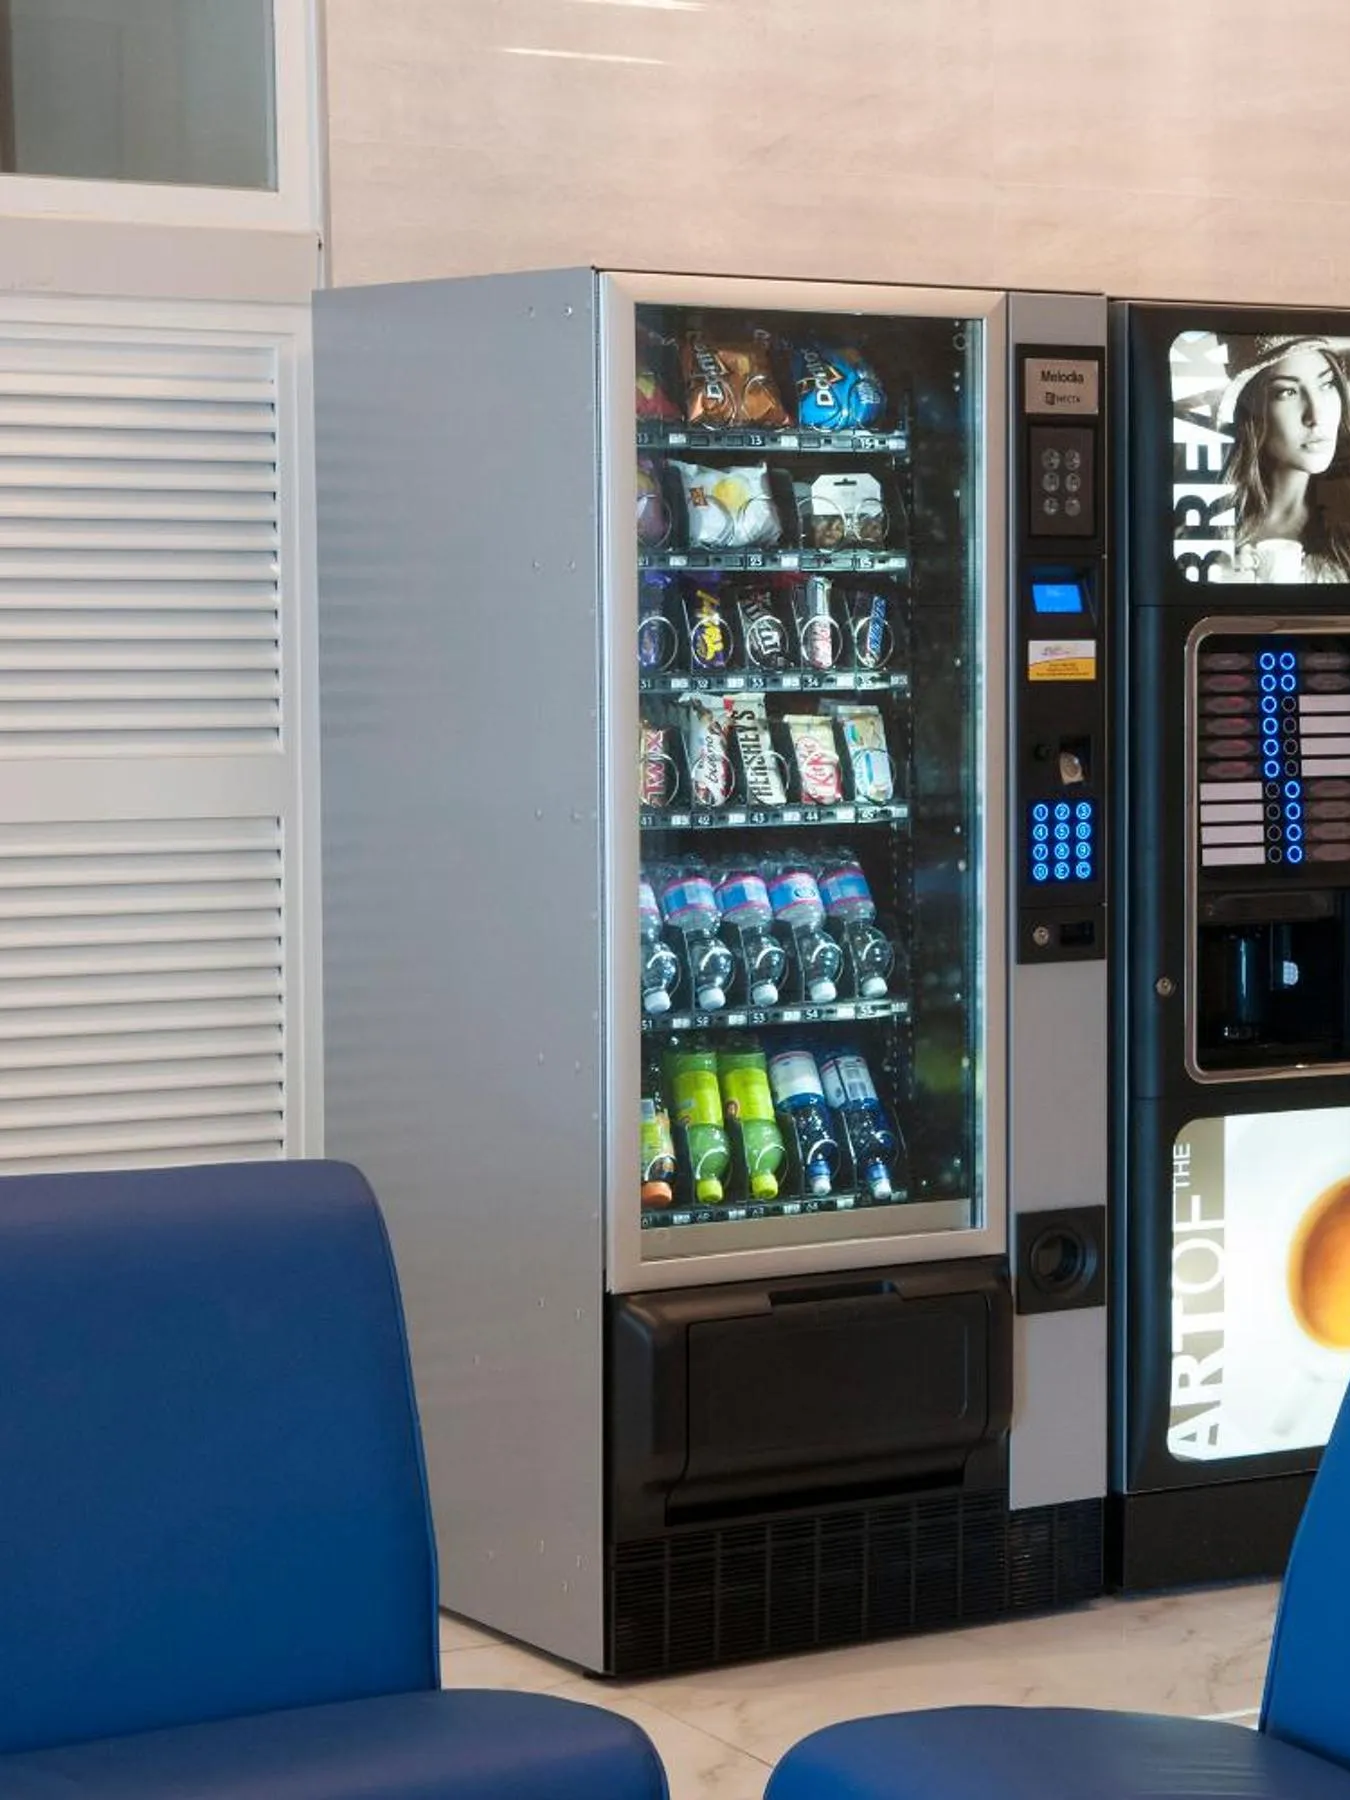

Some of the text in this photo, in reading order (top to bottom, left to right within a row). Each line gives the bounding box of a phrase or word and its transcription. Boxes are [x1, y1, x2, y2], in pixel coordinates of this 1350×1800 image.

[1168, 1143, 1225, 1460] ART OF THE
